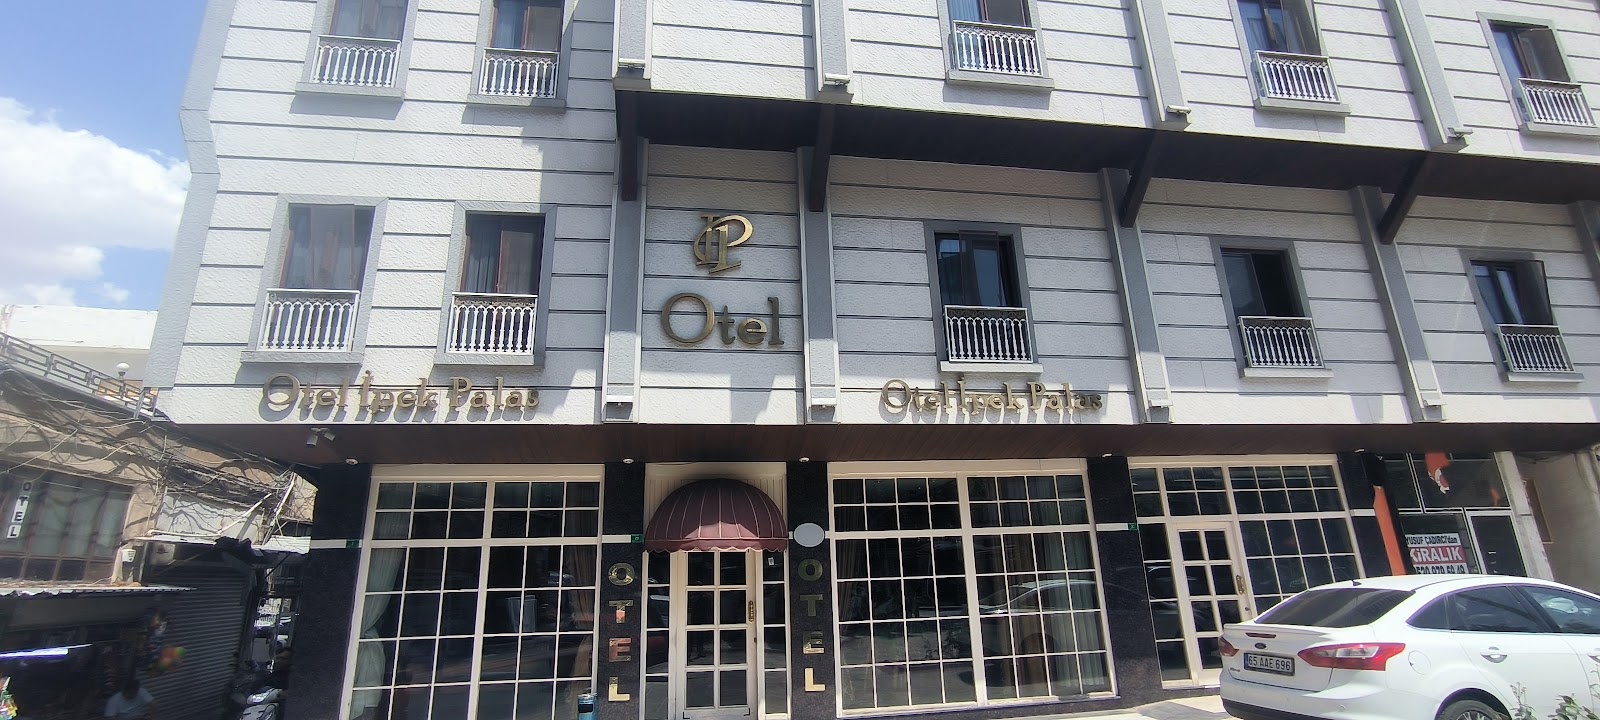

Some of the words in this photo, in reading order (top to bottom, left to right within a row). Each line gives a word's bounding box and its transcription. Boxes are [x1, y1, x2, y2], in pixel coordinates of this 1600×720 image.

[660, 292, 785, 346] Otel
[262, 372, 350, 408] Otel
[448, 375, 540, 409] Palas
[880, 378, 953, 412] Otel
[1026, 380, 1103, 412] Palas
[10, 481, 32, 537] OTEL
[608, 562, 636, 702] OTEL
[798, 558, 826, 692] OTEL
[1248, 655, 1258, 667] 65
[1259, 657, 1274, 669] AAE
[1275, 659, 1291, 671] 696
